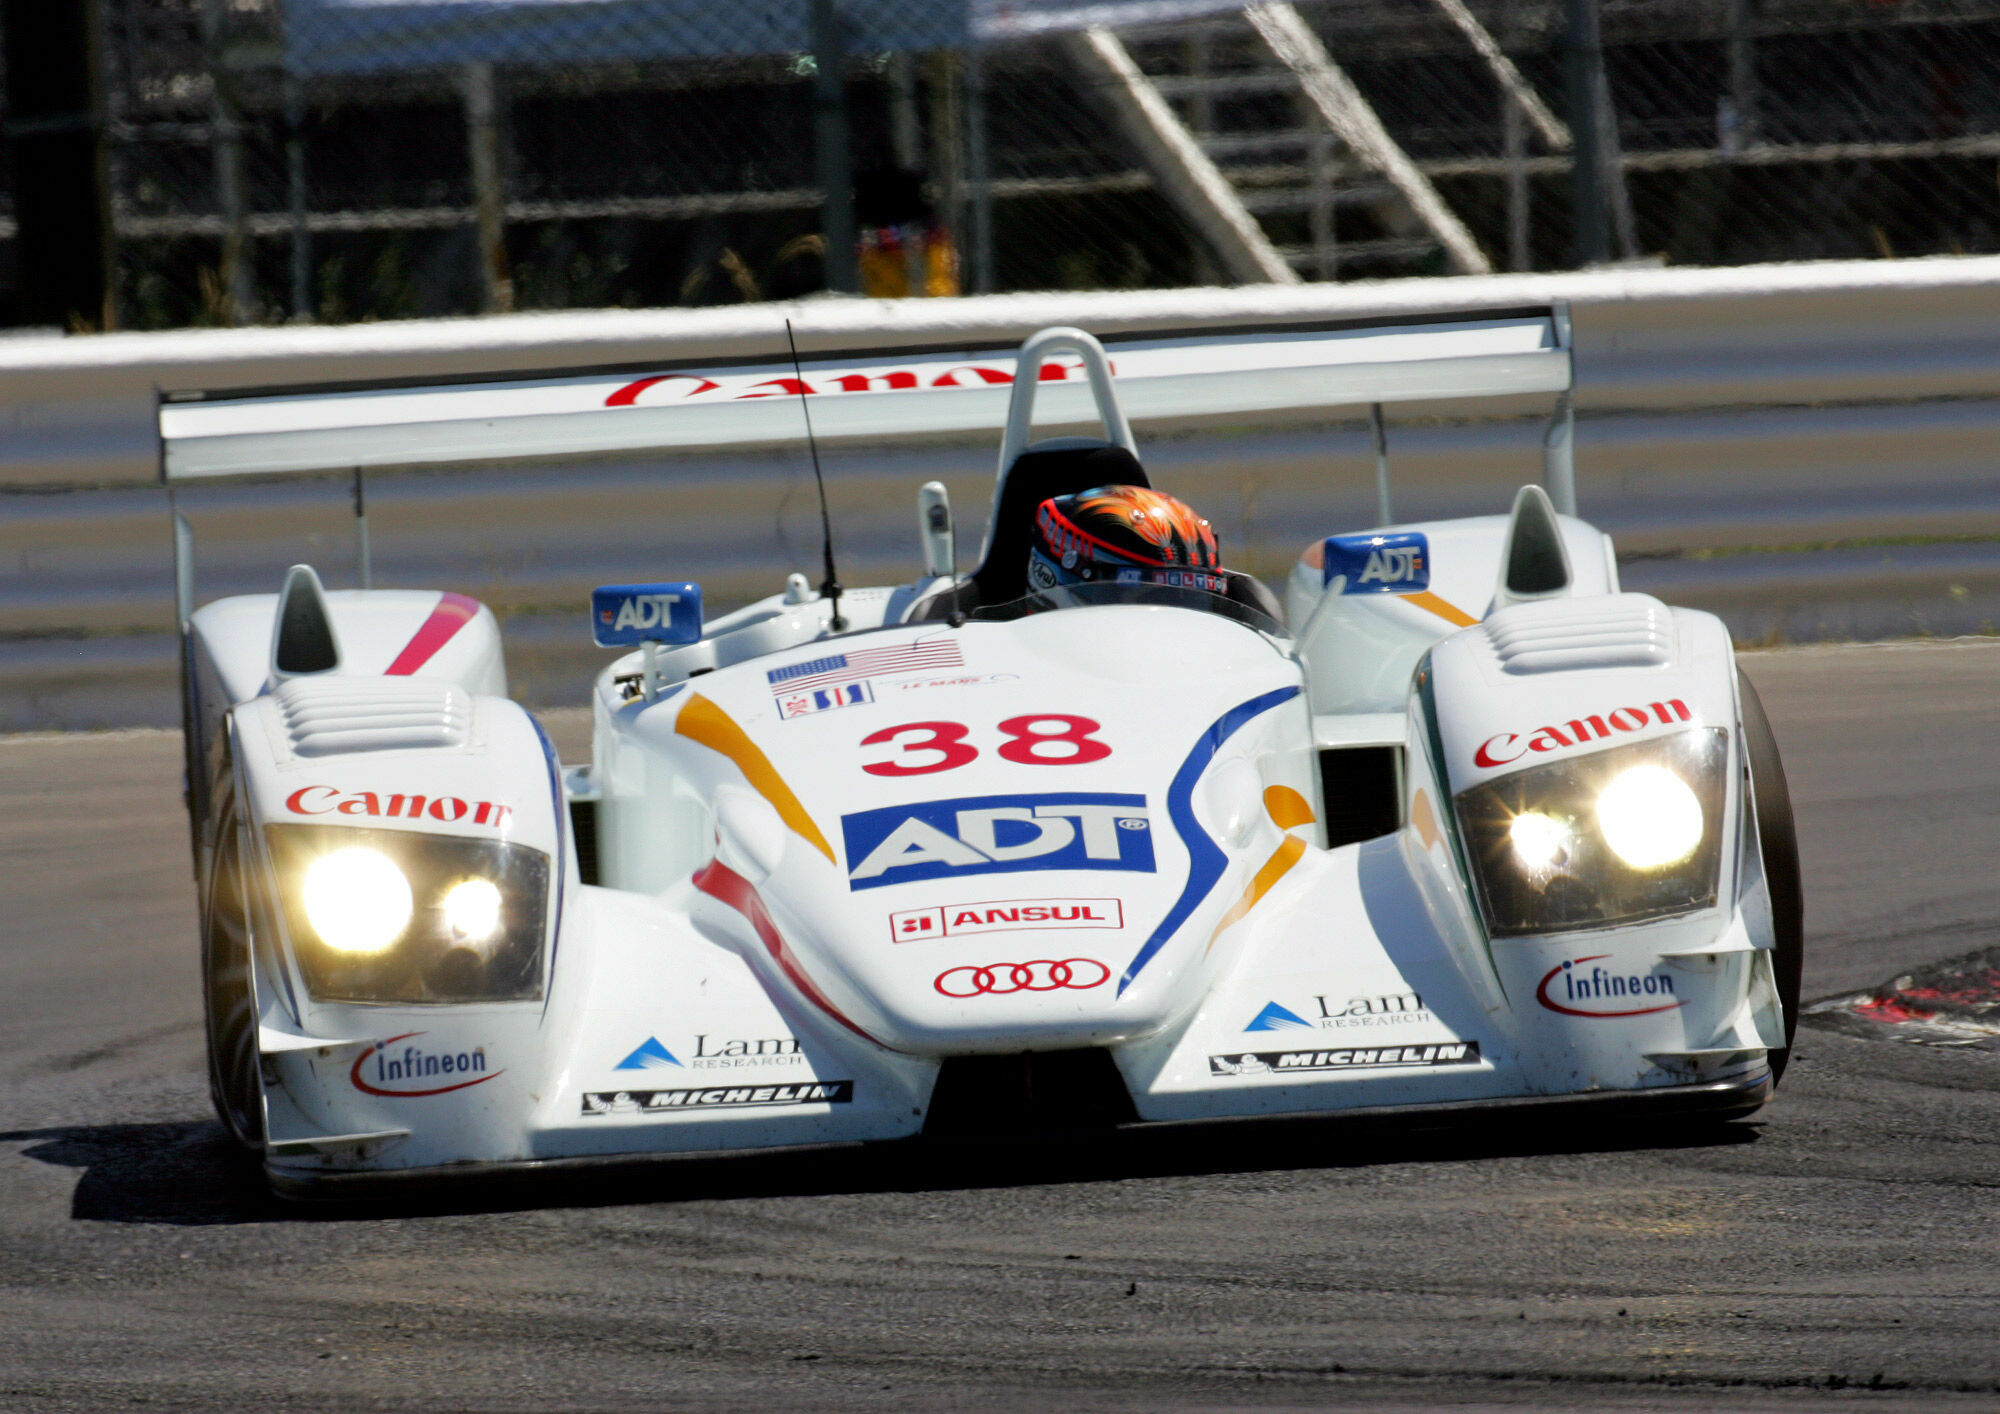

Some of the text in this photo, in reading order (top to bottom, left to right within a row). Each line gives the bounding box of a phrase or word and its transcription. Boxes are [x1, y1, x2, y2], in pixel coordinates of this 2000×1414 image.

[1358, 546, 1420, 584] ADT
[614, 594, 680, 632] ADT
[859, 713, 1113, 777] 38
[1473, 698, 1692, 768] Canon
[285, 785, 512, 828] Canon
[849, 804, 1148, 880] ADT
[952, 905, 1106, 927] ANSUL
[1312, 991, 1424, 1019] Lam
[1321, 1012, 1430, 1029] RESEARCH
[692, 1034, 802, 1058] Lam
[1277, 1043, 1468, 1067] MICHELIN
[692, 1056, 802, 1069] RESEARCH
[652, 1084, 841, 1107] MICHELIN
